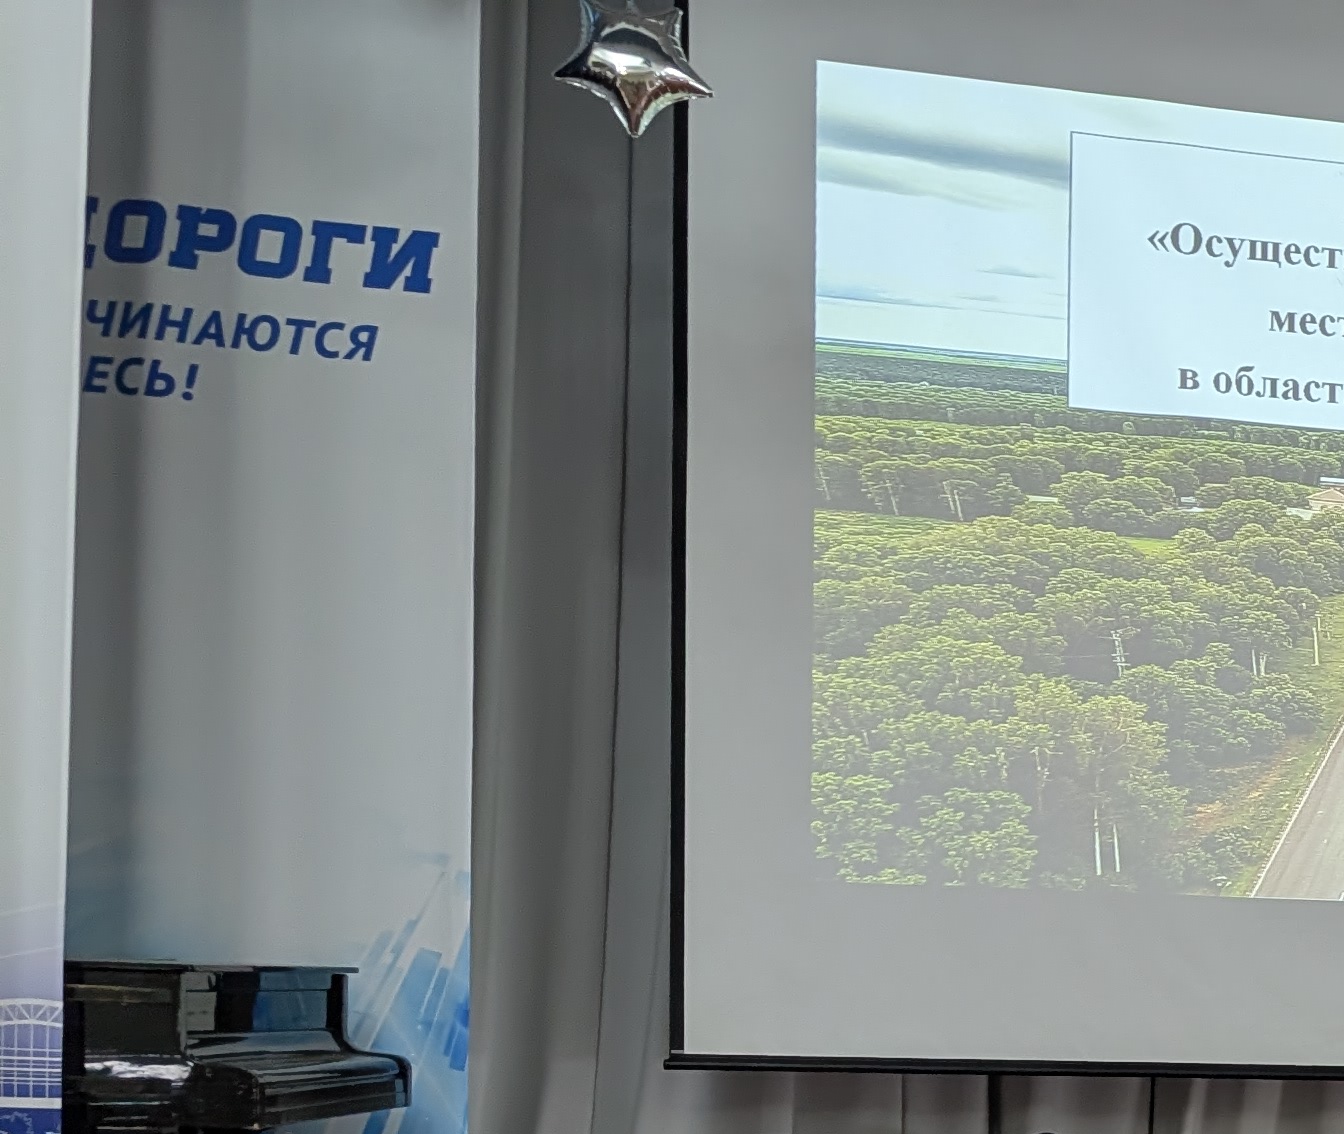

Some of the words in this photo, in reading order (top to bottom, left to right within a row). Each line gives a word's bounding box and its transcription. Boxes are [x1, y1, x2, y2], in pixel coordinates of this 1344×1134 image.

[85, 299, 379, 362] ЧИНАЮТСЯ
[82, 355, 200, 401] ЕСЬ!
[1177, 367, 1200, 390] в
